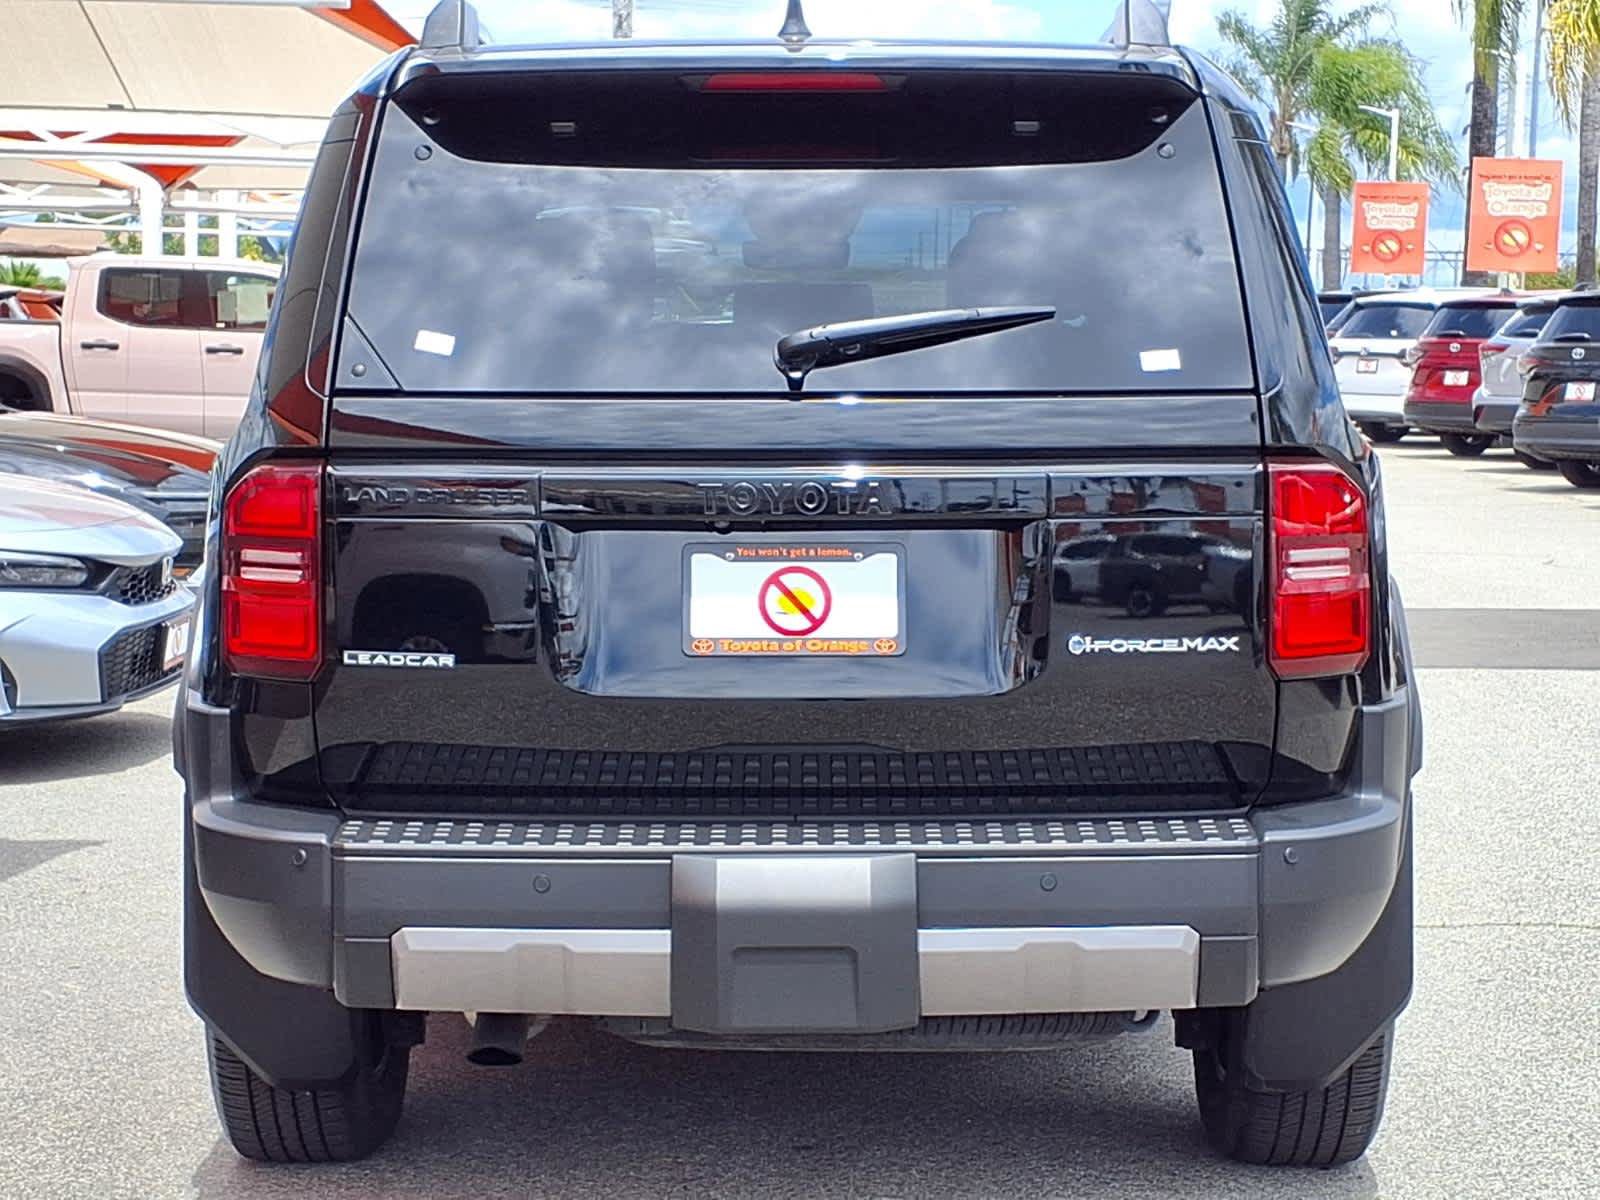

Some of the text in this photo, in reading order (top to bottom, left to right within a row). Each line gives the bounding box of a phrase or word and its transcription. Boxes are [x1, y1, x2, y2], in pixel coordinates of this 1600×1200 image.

[1485, 184, 1550, 200] Toyota of
[1489, 200, 1548, 217] Orange
[344, 487, 528, 504] LAND CRUISER
[696, 481, 893, 516] TOYOTA
[736, 547, 756, 557] You
[758, 546, 787, 557] won't
[789, 546, 807, 559] get
[817, 546, 852, 557] lemon.
[719, 639, 870, 655] Toyota of Orange
[343, 650, 455, 668] LEADCAR
